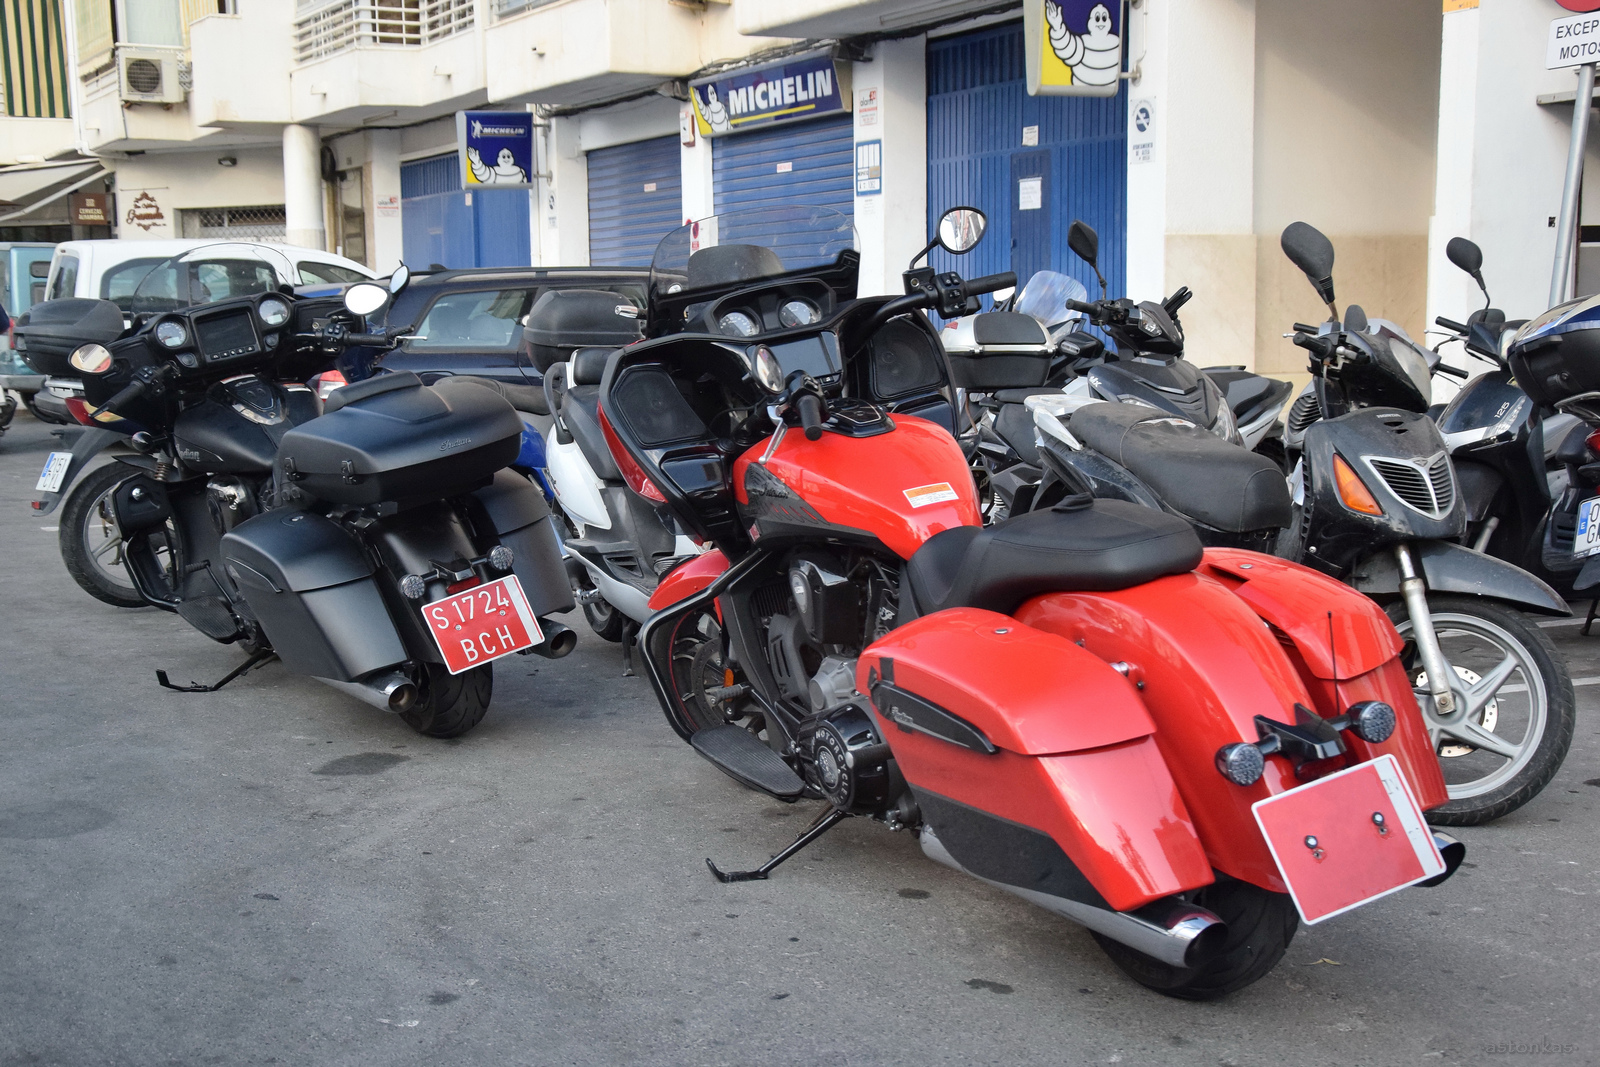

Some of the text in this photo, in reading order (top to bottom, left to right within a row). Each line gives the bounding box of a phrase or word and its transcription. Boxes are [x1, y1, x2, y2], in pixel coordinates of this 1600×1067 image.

[1556, 19, 1600, 39] EXCEP
[728, 68, 833, 116] MICHELIN
[482, 127, 525, 135] MICHELIN
[1493, 401, 1511, 419] 125
[460, 624, 516, 663] BCH
